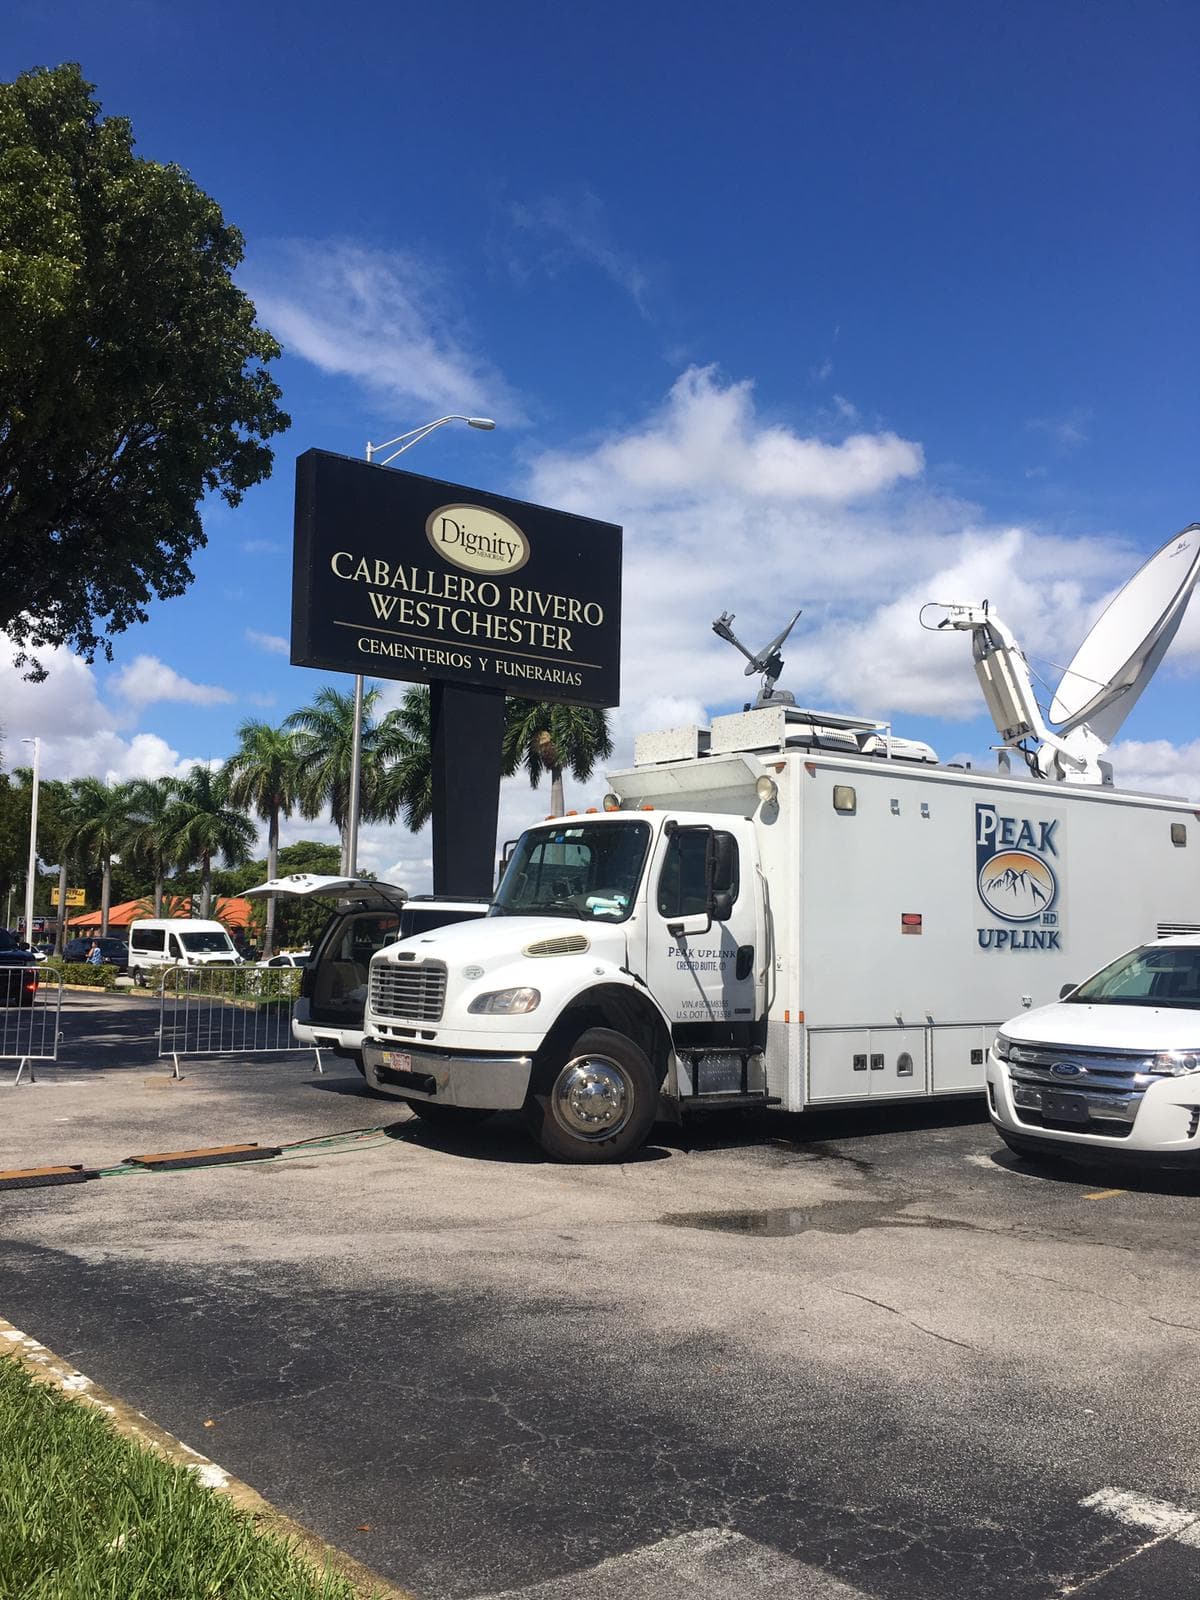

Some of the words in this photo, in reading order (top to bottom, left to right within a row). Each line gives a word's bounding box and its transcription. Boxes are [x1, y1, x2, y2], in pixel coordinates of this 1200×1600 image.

[441, 517, 518, 563] Dignity
[330, 552, 500, 607] CABALLERO
[509, 586, 604, 626] RIVERO
[367, 591, 574, 651] WESTCHESTER
[358, 637, 472, 669] CEMENTERIOS
[478, 658, 488, 672] Y
[495, 660, 583, 686] FUNERARIAS
[976, 808, 1057, 856] PEAK
[1042, 913, 1057, 924] HD
[668, 946, 695, 958] PEAK
[698, 949, 737, 958] UPLINK
[976, 928, 1060, 950] UPLINK
[676, 961, 700, 971] CRESTED
[689, 1010, 704, 1018] DOT
